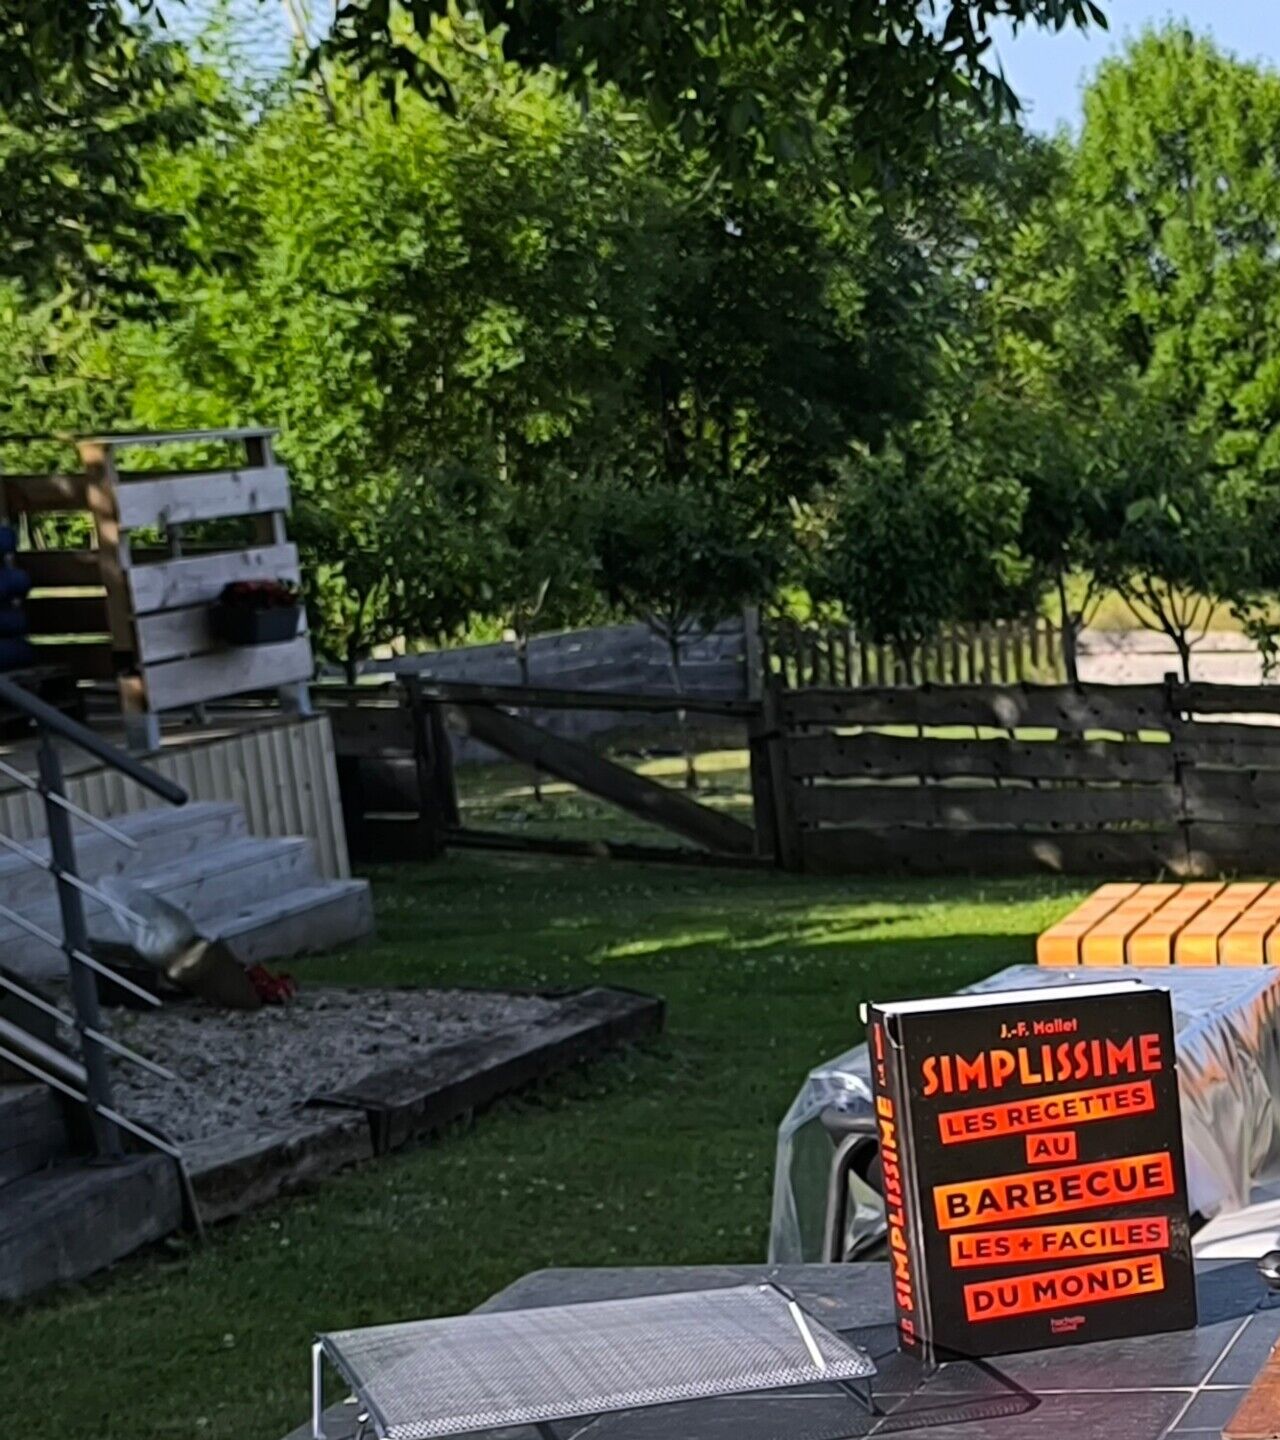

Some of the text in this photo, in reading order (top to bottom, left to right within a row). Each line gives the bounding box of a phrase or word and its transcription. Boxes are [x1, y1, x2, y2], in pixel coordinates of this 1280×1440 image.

[921, 1033, 1163, 1096] SIMPLISSIME
[946, 1086, 1147, 1137] LES RECETTES
[1032, 1137, 1071, 1159] AU
[876, 1094, 915, 1312] SIMPLISSIME
[945, 1161, 1166, 1220] BARBECUE
[956, 1235, 1012, 1260] LES
[1041, 1221, 1162, 1253] FACILES
[972, 1262, 1156, 1314] DU MONDE
